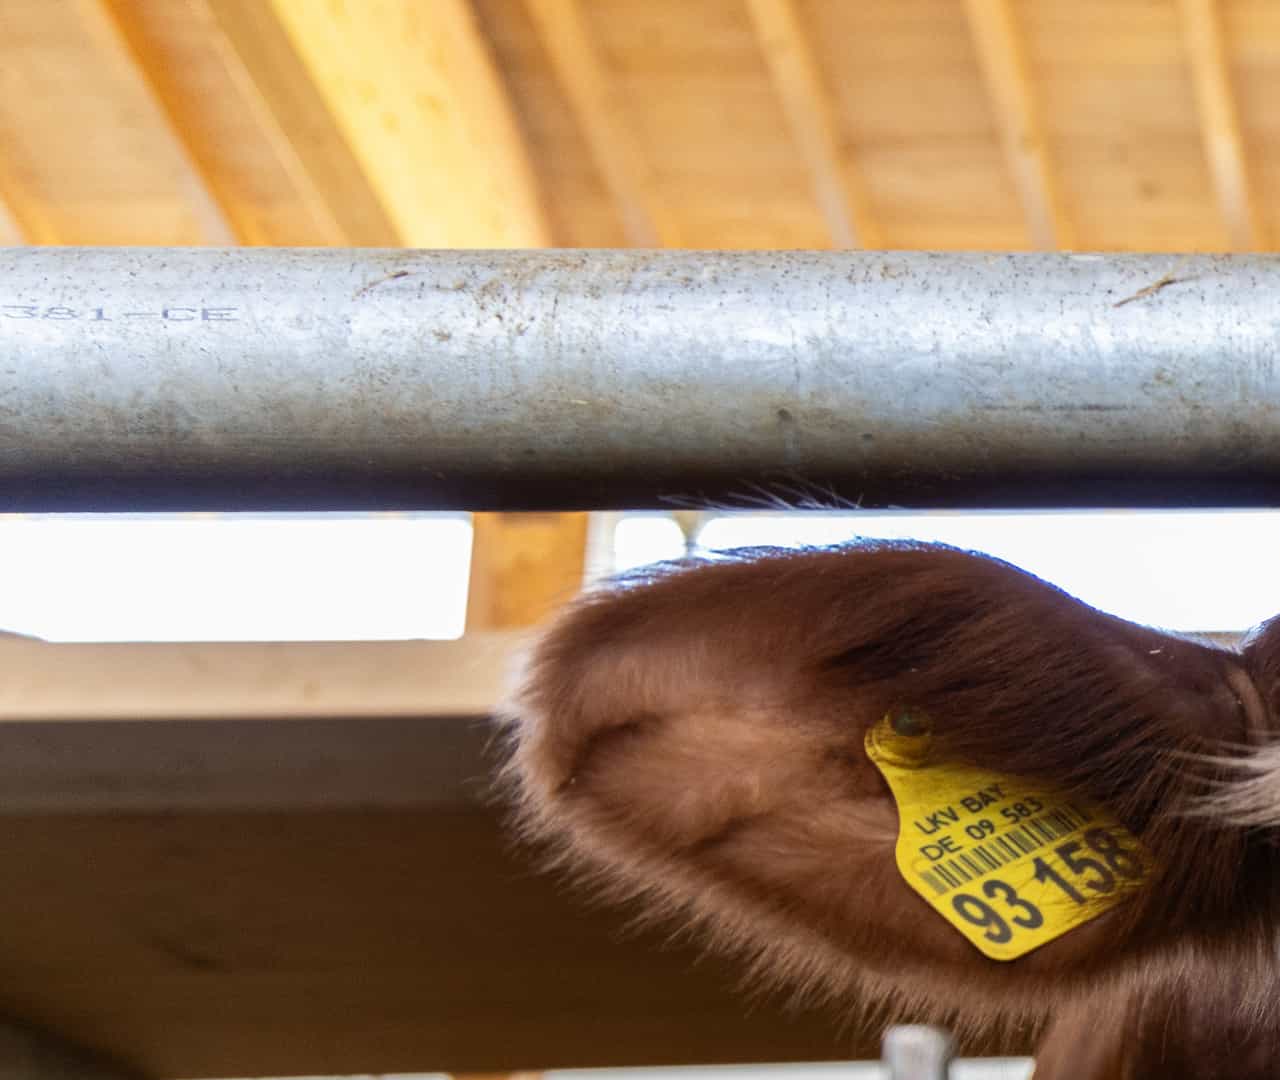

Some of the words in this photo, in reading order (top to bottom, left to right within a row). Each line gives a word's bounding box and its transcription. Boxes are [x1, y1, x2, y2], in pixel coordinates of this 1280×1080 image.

[914, 805, 958, 836] LKV
[961, 783, 1009, 814] BAY
[919, 836, 962, 862] DE
[965, 819, 996, 841] 09
[1000, 796, 1044, 824] 583
[951, 879, 1045, 944] 93
[1033, 828, 1142, 904] 158
